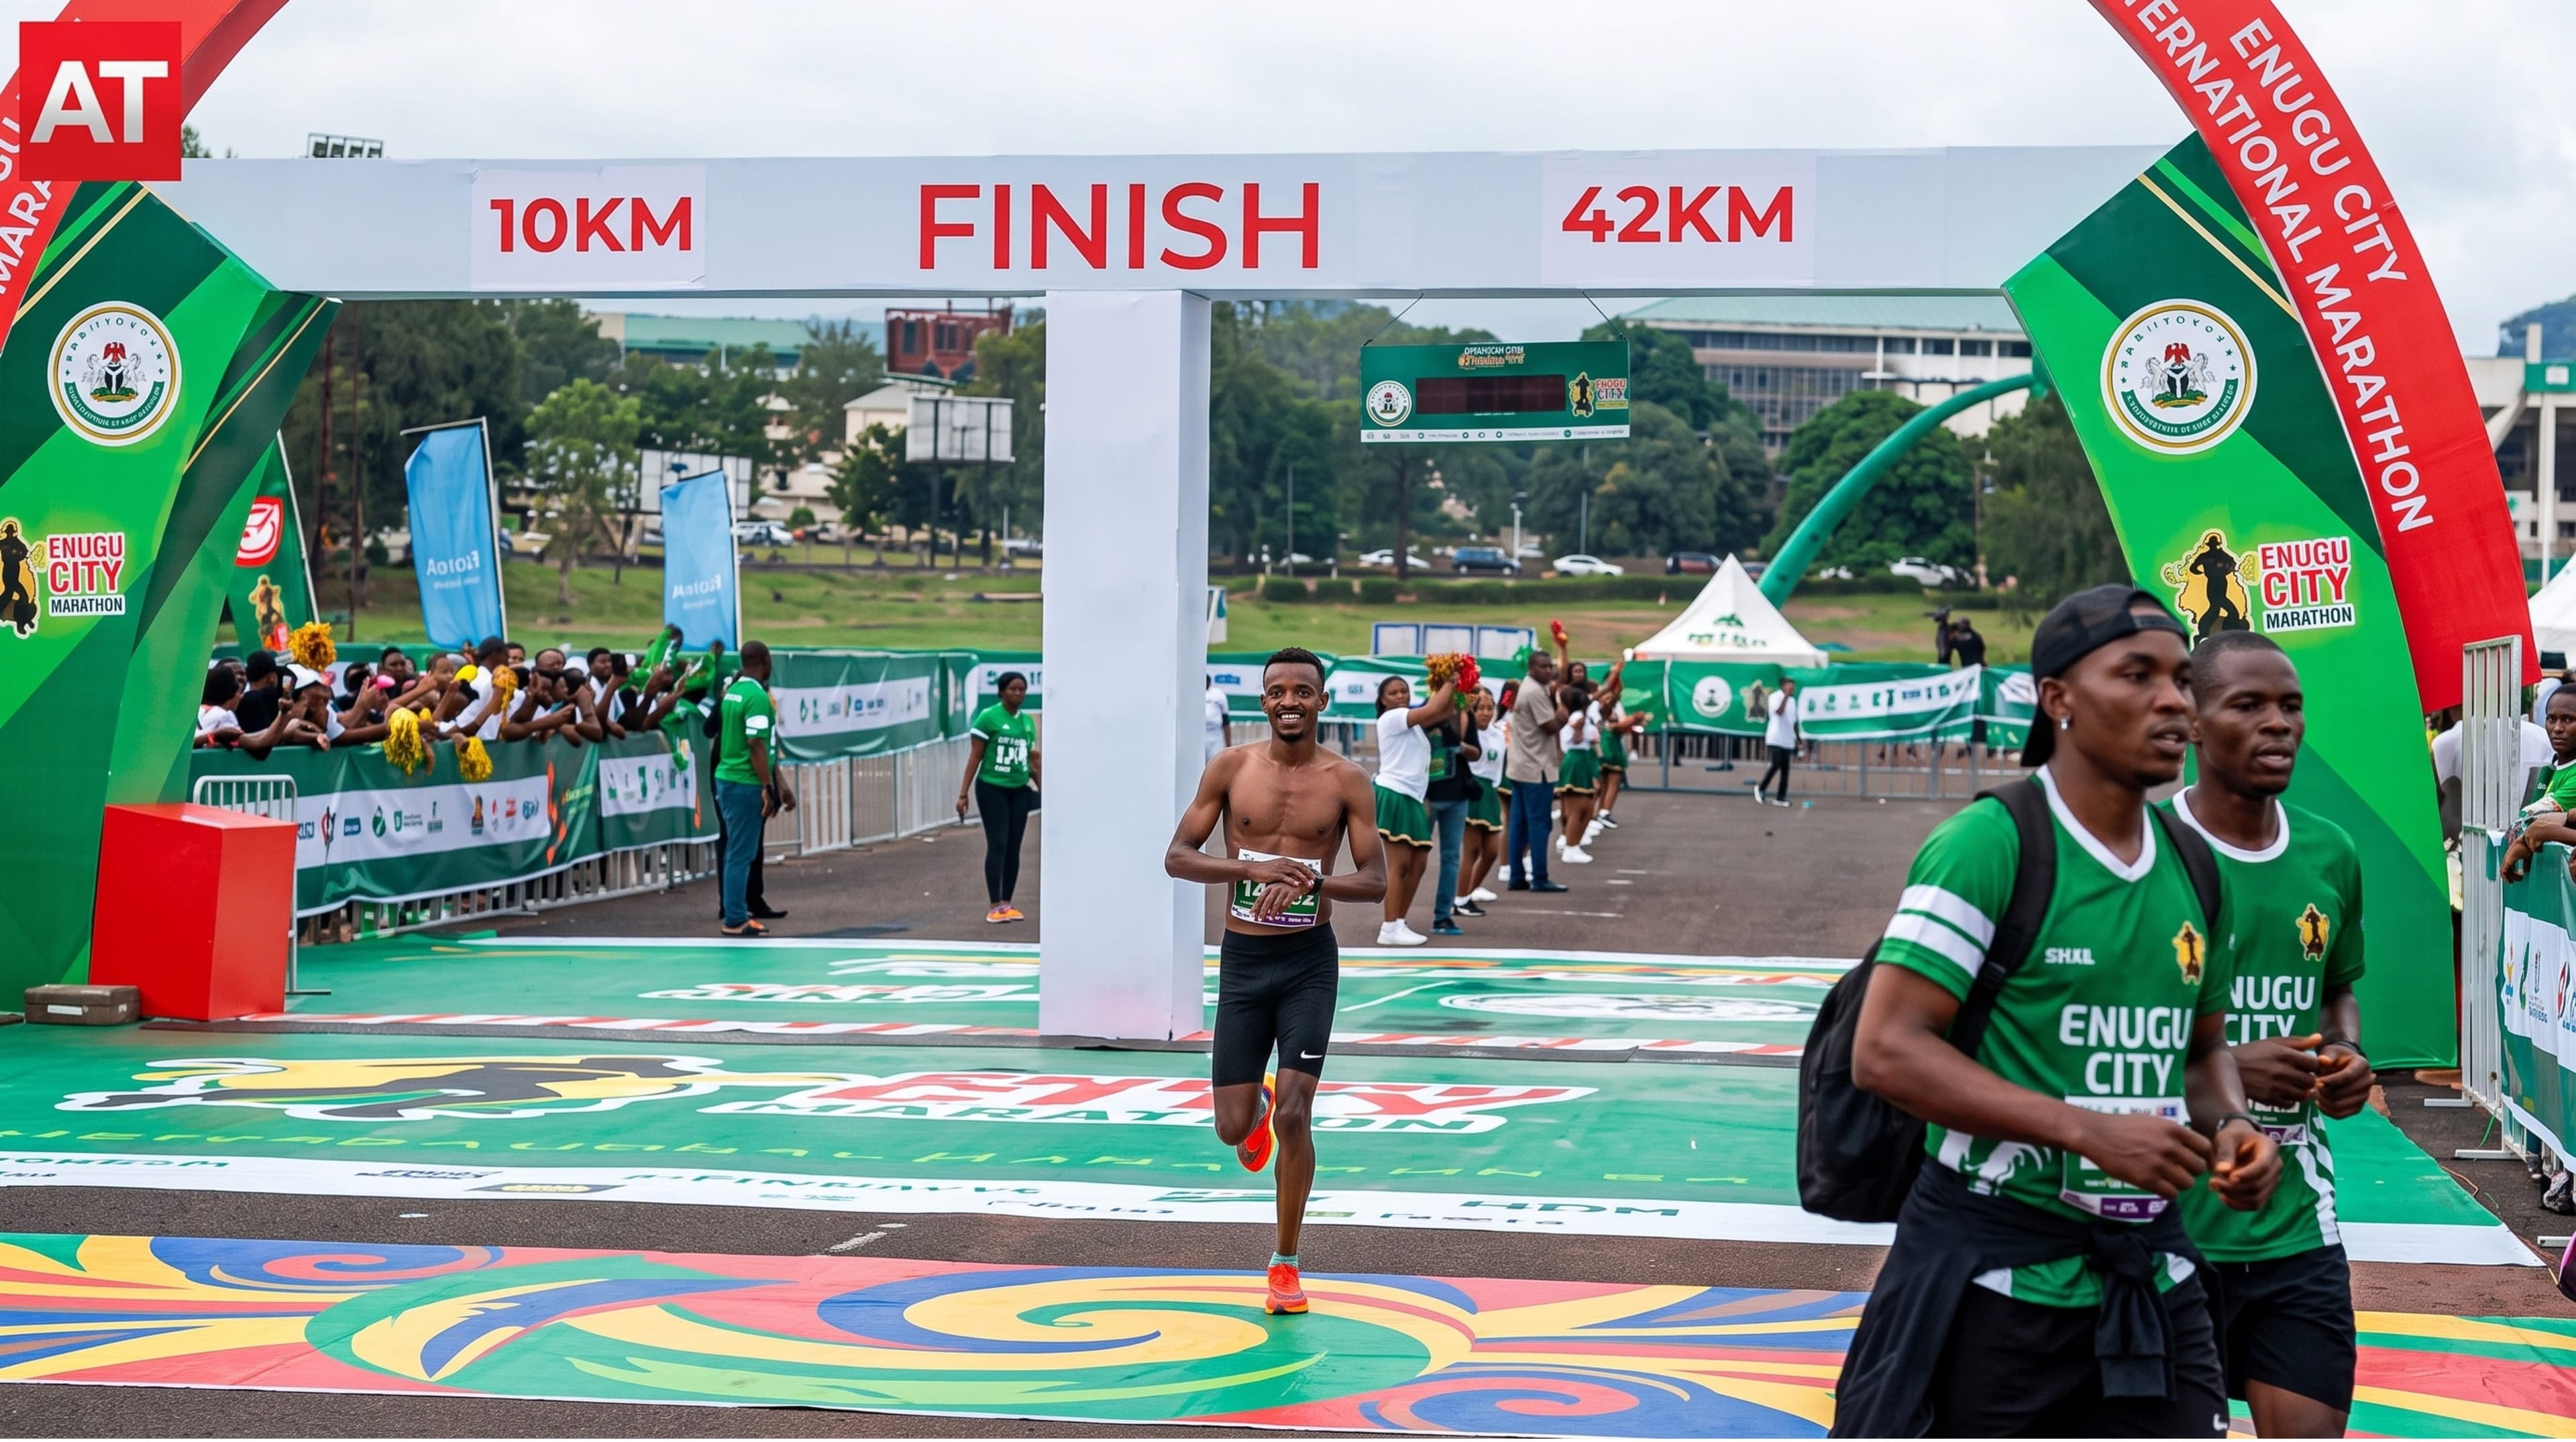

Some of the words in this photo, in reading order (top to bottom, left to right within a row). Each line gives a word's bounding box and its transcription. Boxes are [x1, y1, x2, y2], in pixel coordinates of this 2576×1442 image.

[2229, 17, 2351, 176] ENUGU
[2332, 185, 2408, 282] CITY
[490, 196, 692, 253] 10KM
[919, 181, 1320, 270] FINISH
[1562, 185, 1793, 243] 42KM
[2124, 0, 2322, 264] ERNATIONAL
[2304, 263, 2434, 534] MARATHON
[48, 535, 123, 559] ENUGU
[2261, 539, 2349, 570] ENUGU
[50, 560, 123, 593] CITY
[2263, 567, 2348, 606] CITY
[51, 598, 123, 613] MARATHON
[2266, 606, 2352, 629] MARATHON
[2229, 975, 2316, 1011] NUGU
[2058, 1004, 2193, 1050] ENUGU
[2084, 1052, 2175, 1097] CITY
[733, 1103, 1474, 1130] MARATON
